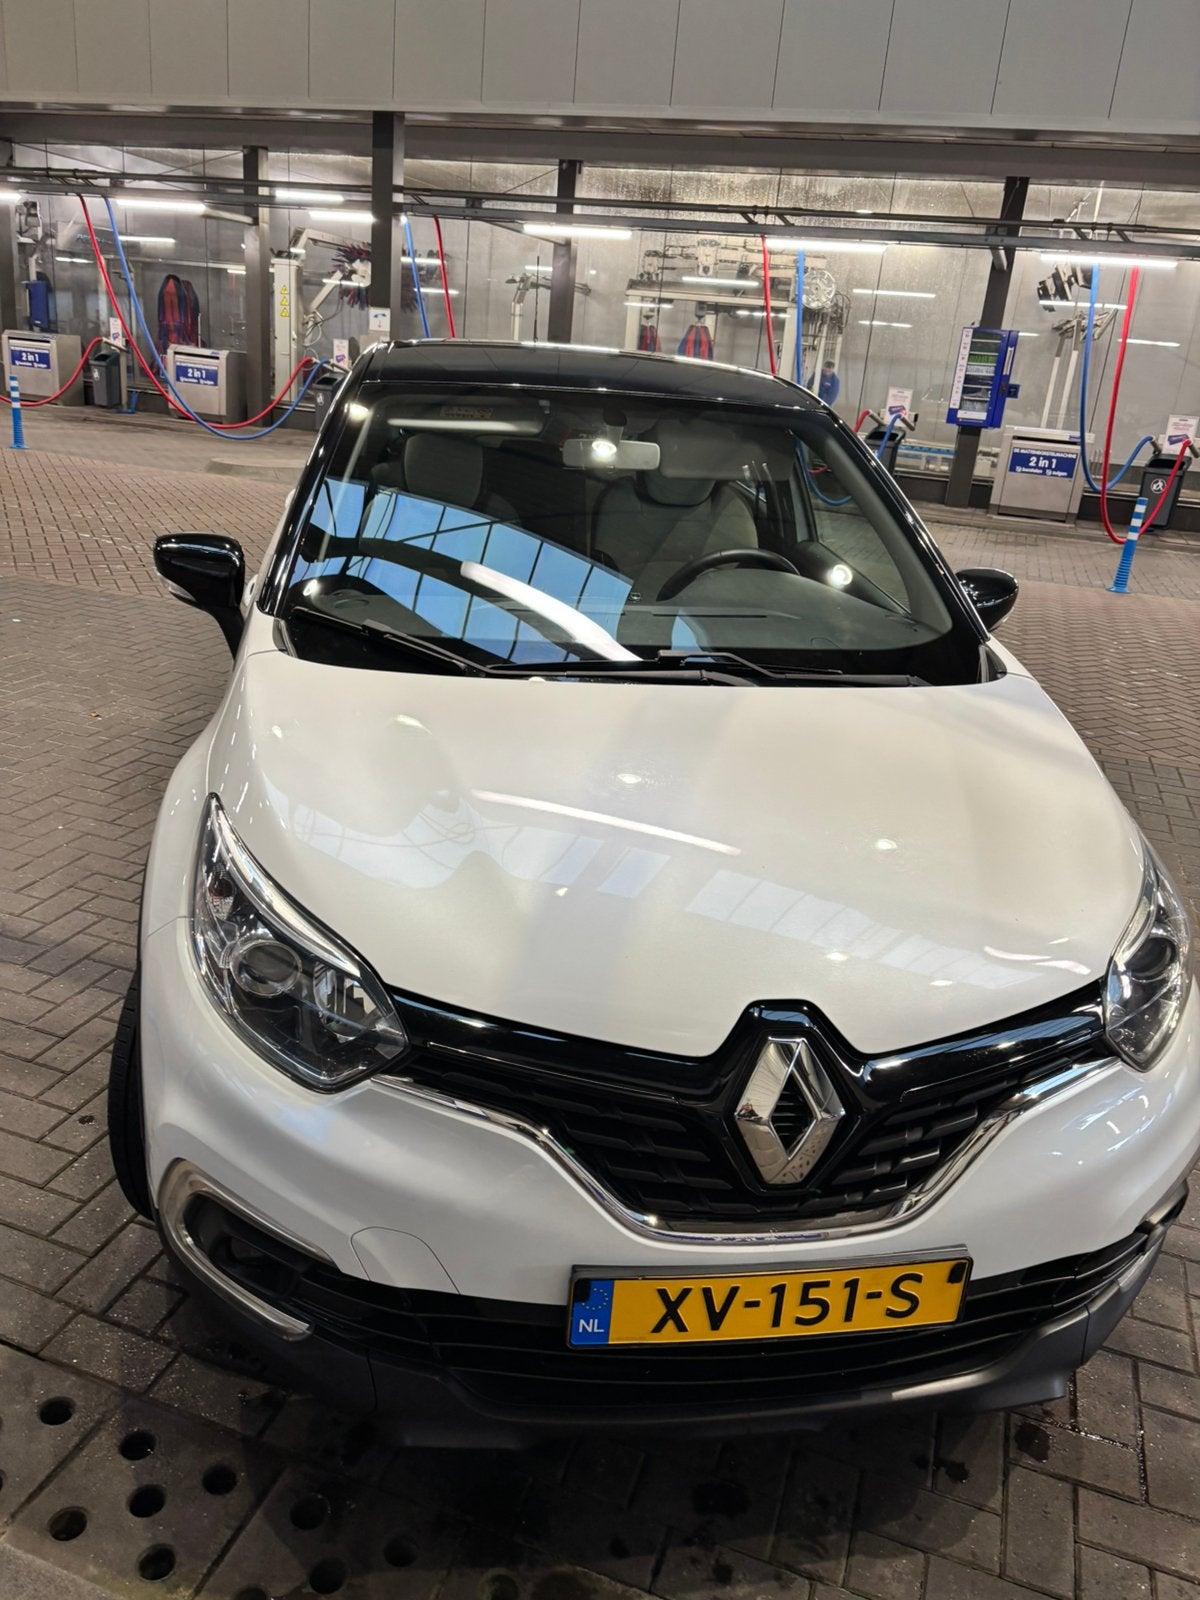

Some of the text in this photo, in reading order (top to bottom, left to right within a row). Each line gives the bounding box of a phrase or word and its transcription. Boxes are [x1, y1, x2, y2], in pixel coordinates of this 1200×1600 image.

[22, 352, 39, 362] 2 in 1
[188, 368, 206, 379] 2 in 1
[1029, 456, 1057, 469] 2 in 1
[651, 1272, 924, 1334] XV-151-S
[578, 1318, 604, 1333] NL
